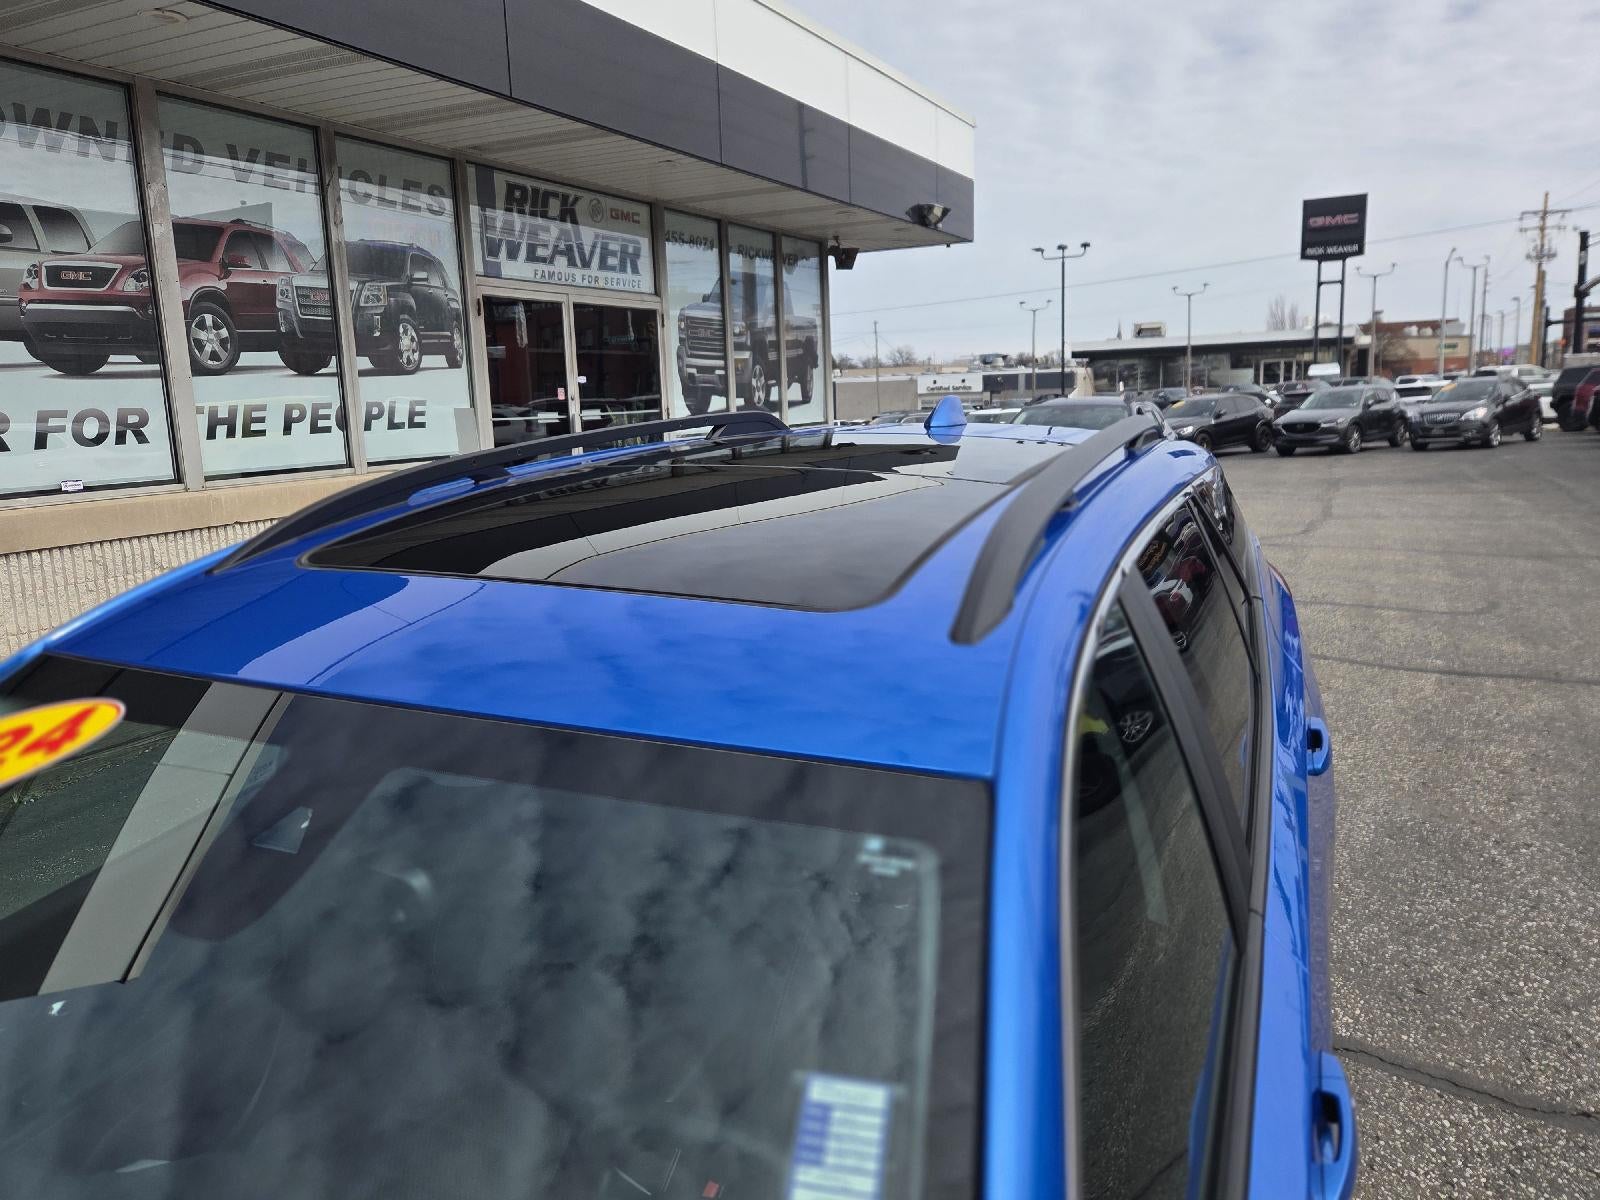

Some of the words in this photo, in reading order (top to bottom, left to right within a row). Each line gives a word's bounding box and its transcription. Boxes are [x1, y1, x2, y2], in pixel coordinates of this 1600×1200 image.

[0, 102, 205, 174] WND
[504, 181, 583, 225] RICK
[610, 208, 640, 224] GMC
[1309, 213, 1358, 227] GMC
[485, 213, 642, 275] WEAVER
[1326, 243, 1358, 254] WEAVER
[61, 271, 92, 280] GMC
[533, 269, 577, 283] FAMOUS
[581, 274, 600, 285] FOR
[604, 277, 642, 289] SERVICE
[34, 408, 150, 450] FOR
[196, 402, 267, 440] HE
